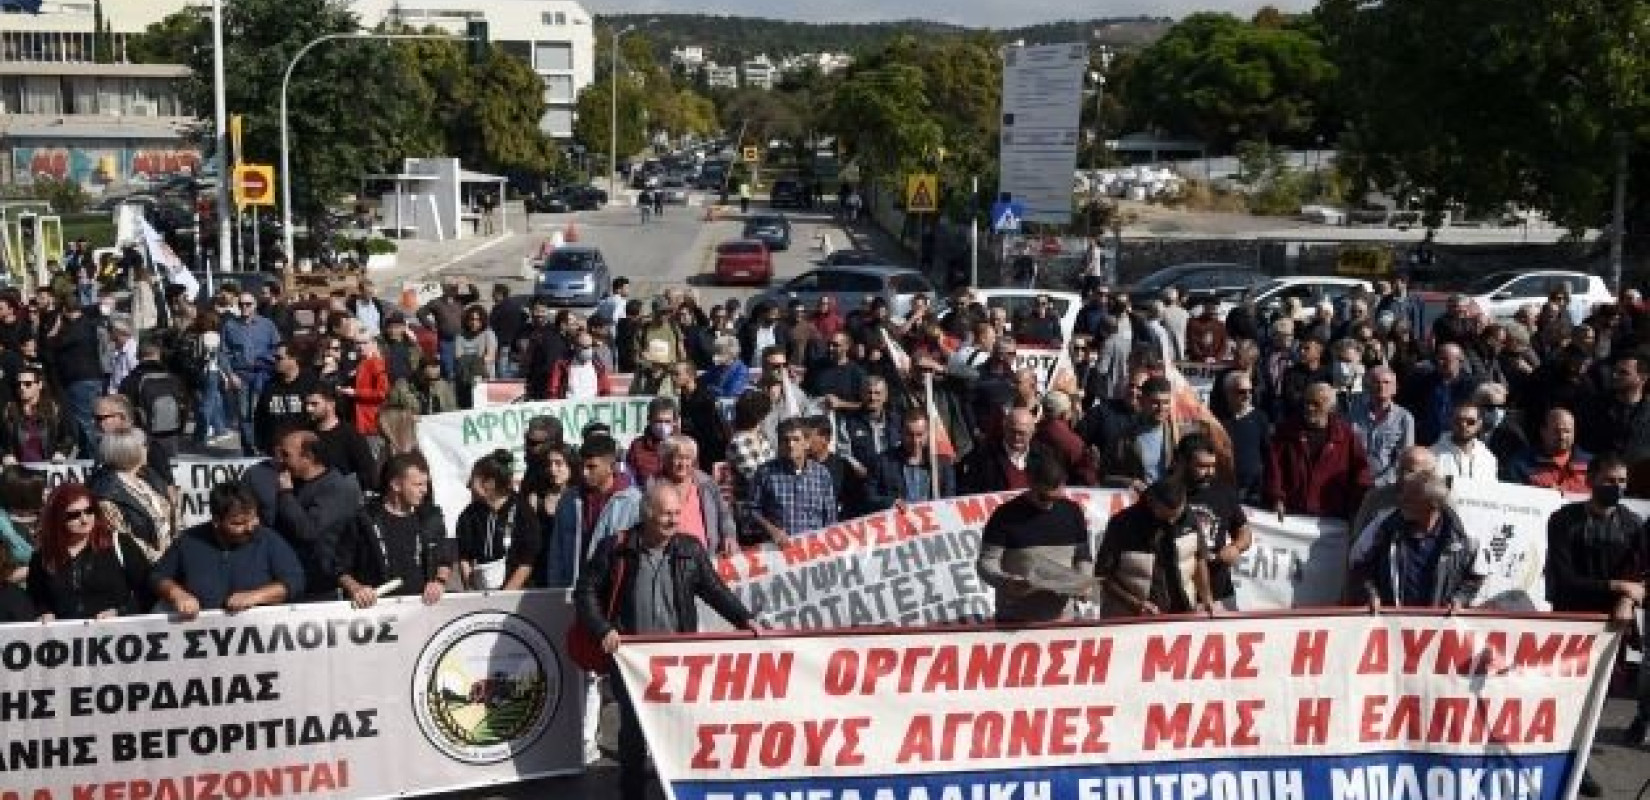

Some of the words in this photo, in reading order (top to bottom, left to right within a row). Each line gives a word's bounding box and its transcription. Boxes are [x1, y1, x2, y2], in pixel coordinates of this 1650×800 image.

[736, 552, 864, 614] ΑΛΥΨΗ
[760, 569, 943, 629] ΤΟΤΑΤΕΣ
[0, 632, 169, 672] ΟΦΙΚΟΣ
[183, 616, 399, 662] ΣΥΛΛΟΓΟΣ
[644, 652, 794, 703] ΣΤΗΝ
[824, 637, 1114, 696] ΟΡΓΑΝΩΣΗ
[1142, 632, 1266, 682] ΜΑΣ
[1291, 630, 1329, 675] Η
[1357, 627, 1597, 676] ΔΥΝΑΜΗ
[70, 671, 281, 717] ΕΟΡΔΑΙΑΣ
[112, 708, 379, 762] ΒΕΓΟΡΙΤΙΔΑΣ
[691, 718, 870, 770] ΣΤΟΥΣ
[896, 705, 1116, 764] ΑΓΩΝΕΣ
[1142, 700, 1266, 750] ΜΑΣ
[1294, 698, 1332, 746] Η
[1358, 694, 1557, 745] ΕΛΠΙΔΑ
[1078, 770, 1303, 800] ΕΠΙΤΡΟΠΗ
